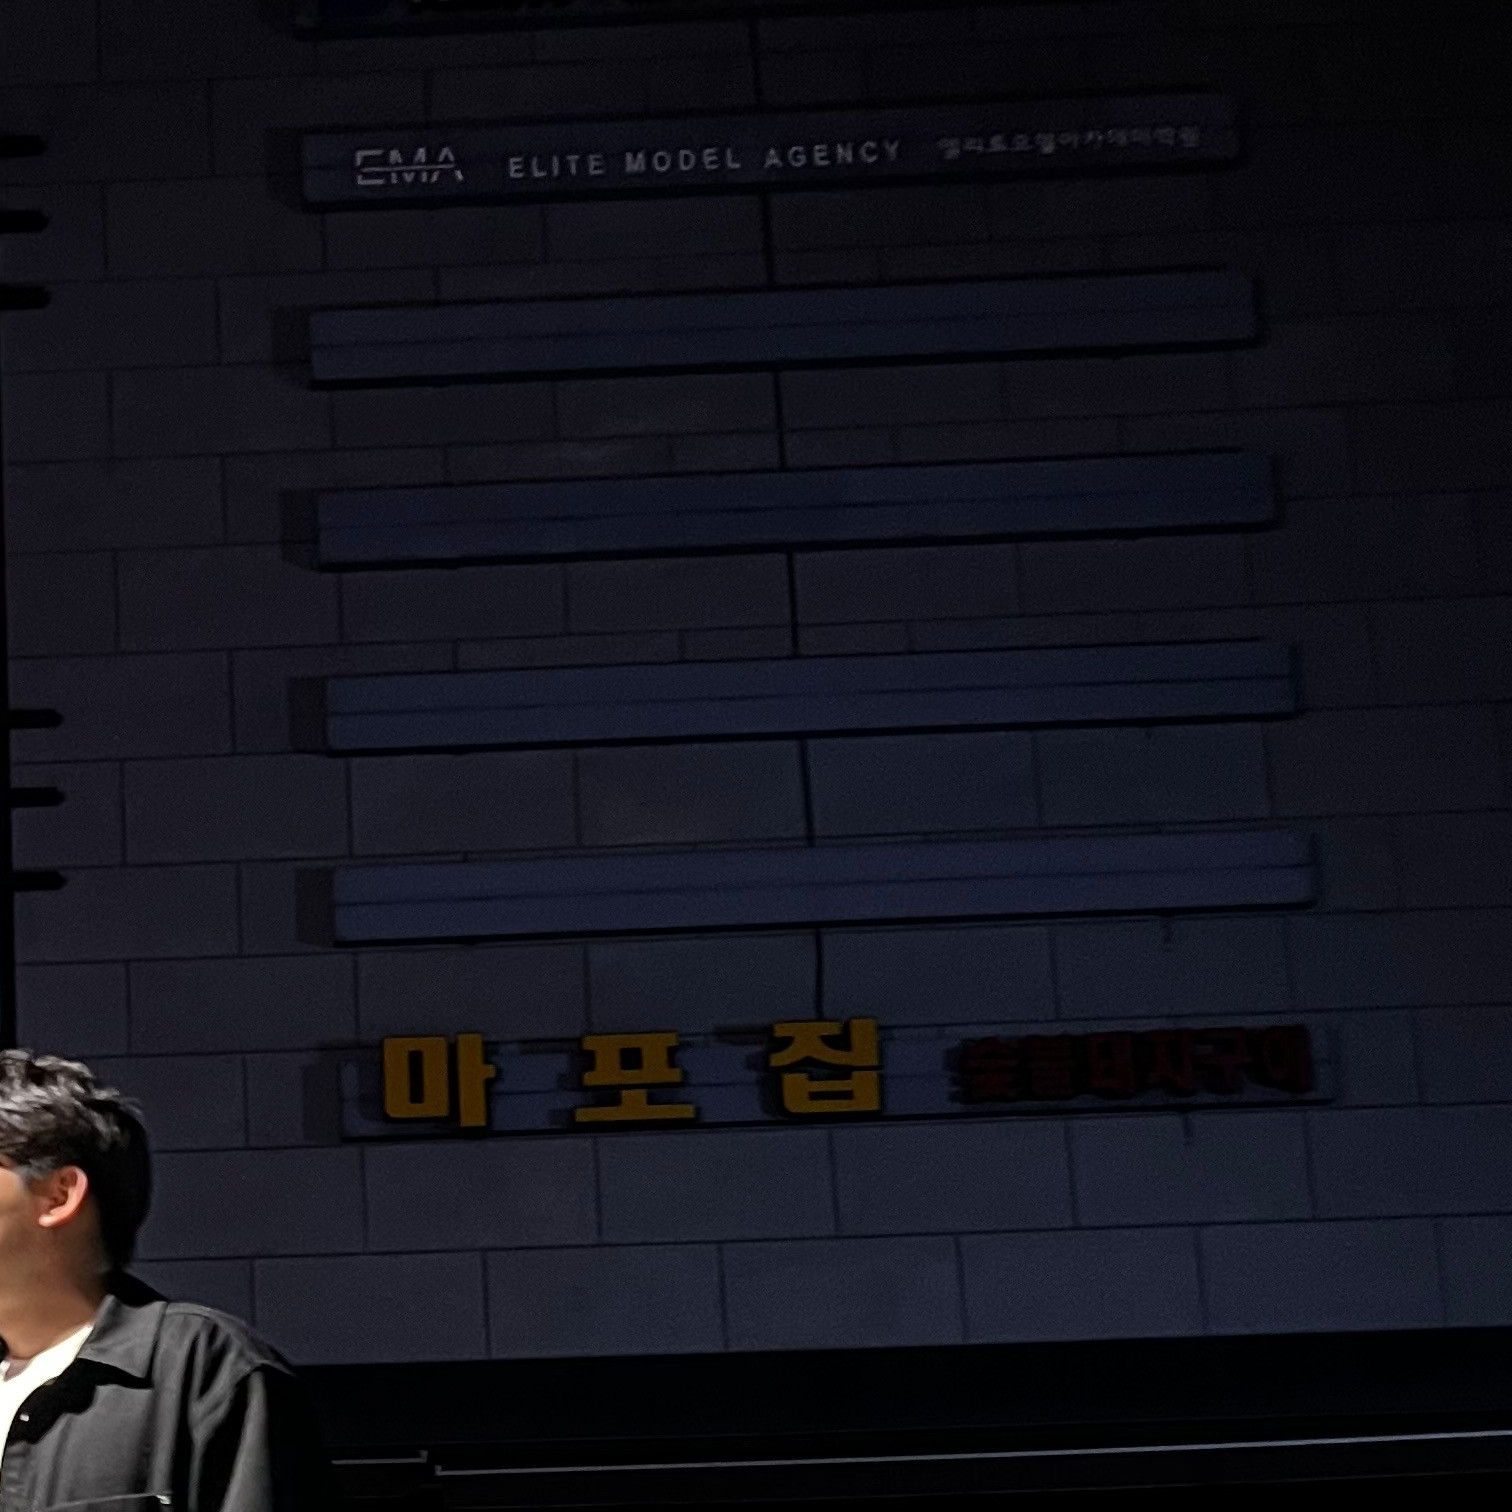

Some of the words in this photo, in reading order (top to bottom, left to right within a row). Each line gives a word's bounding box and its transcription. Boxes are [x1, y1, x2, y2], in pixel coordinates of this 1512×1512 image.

[354, 146, 465, 190] EMA
[507, 156, 606, 181] ELITE
[623, 149, 744, 176] MODEL
[763, 138, 902, 171] AGENCY
